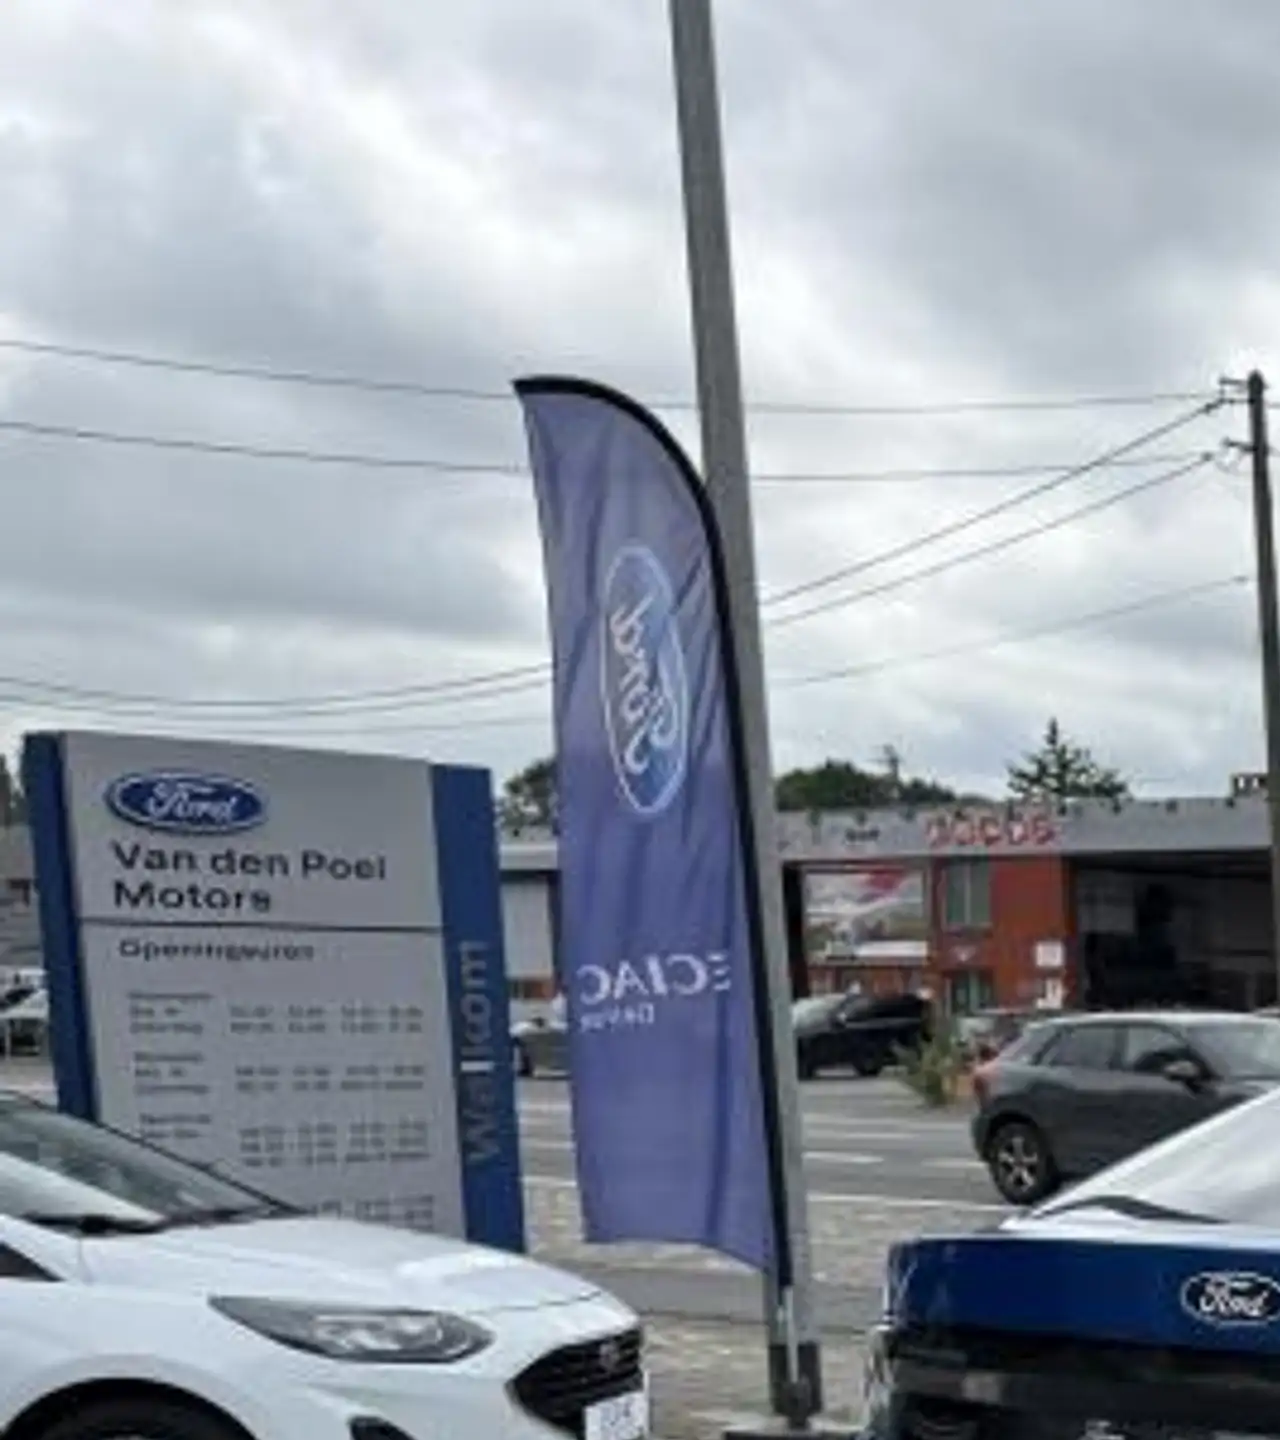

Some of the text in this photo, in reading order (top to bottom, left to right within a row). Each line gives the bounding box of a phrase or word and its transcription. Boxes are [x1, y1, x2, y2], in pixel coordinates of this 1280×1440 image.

[148, 780, 239, 825] Ford
[111, 841, 387, 881] Van den Poel
[112, 880, 272, 913] Motors
[1199, 1273, 1270, 1318] Ford
